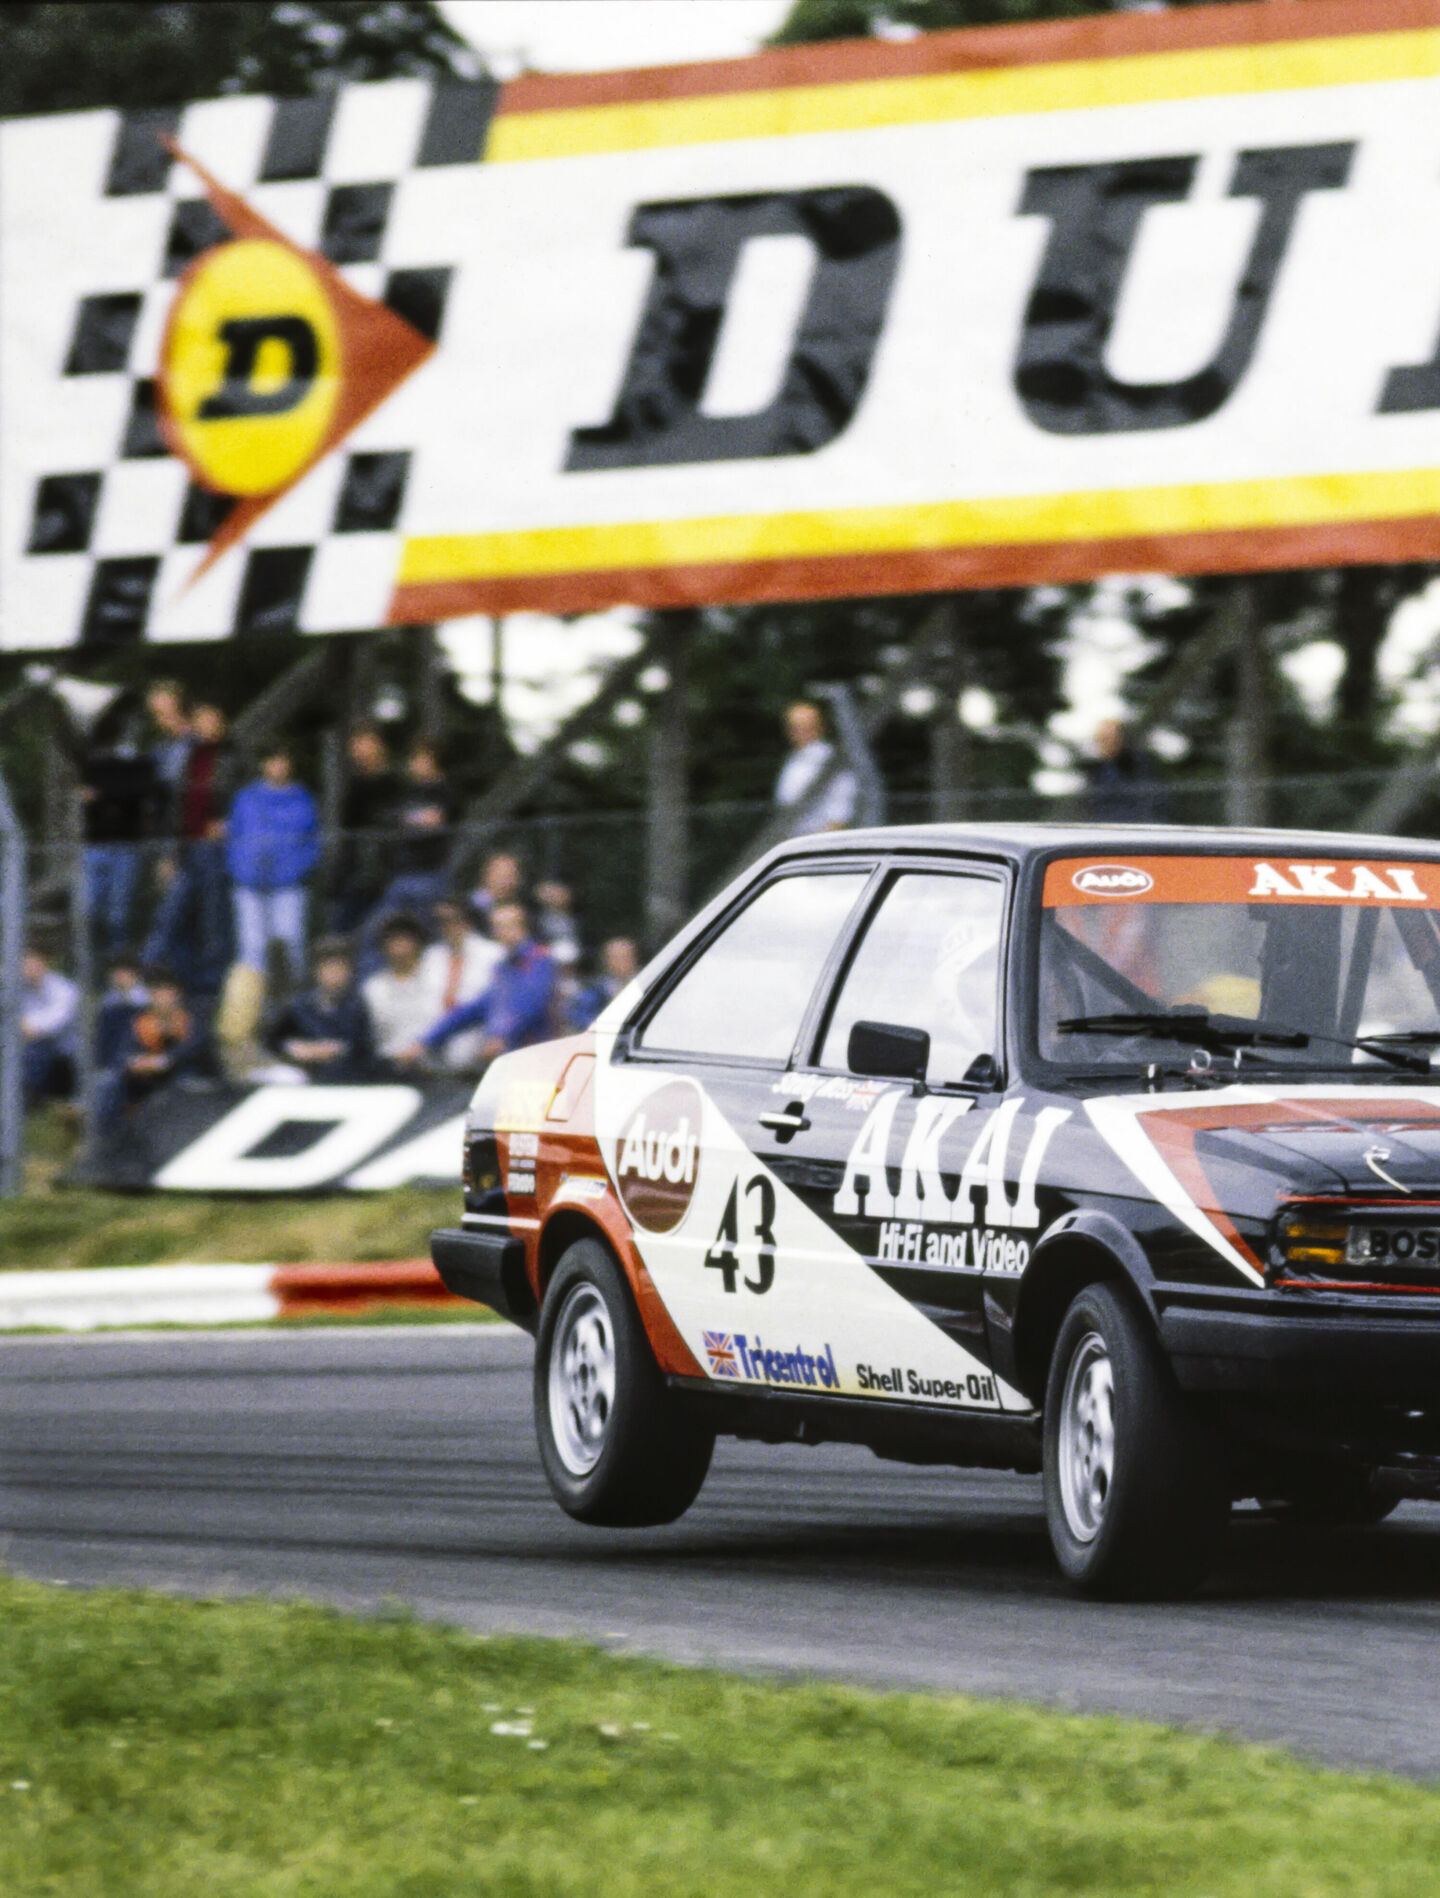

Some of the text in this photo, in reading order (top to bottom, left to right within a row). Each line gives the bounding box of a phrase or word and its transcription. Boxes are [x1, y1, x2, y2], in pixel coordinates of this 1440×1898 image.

[194, 312, 321, 420] D
[1080, 872, 1148, 888] Audi
[1249, 863, 1427, 900] AKAI
[617, 1113, 698, 1184] Audi
[833, 1089, 1073, 1228] AKAI
[704, 1172, 777, 1295] 43
[877, 1221, 1030, 1274] Hi-Fi and Video
[732, 1334, 840, 1389] Tricentrol
[855, 1363, 995, 1402] Shell Super Oil
